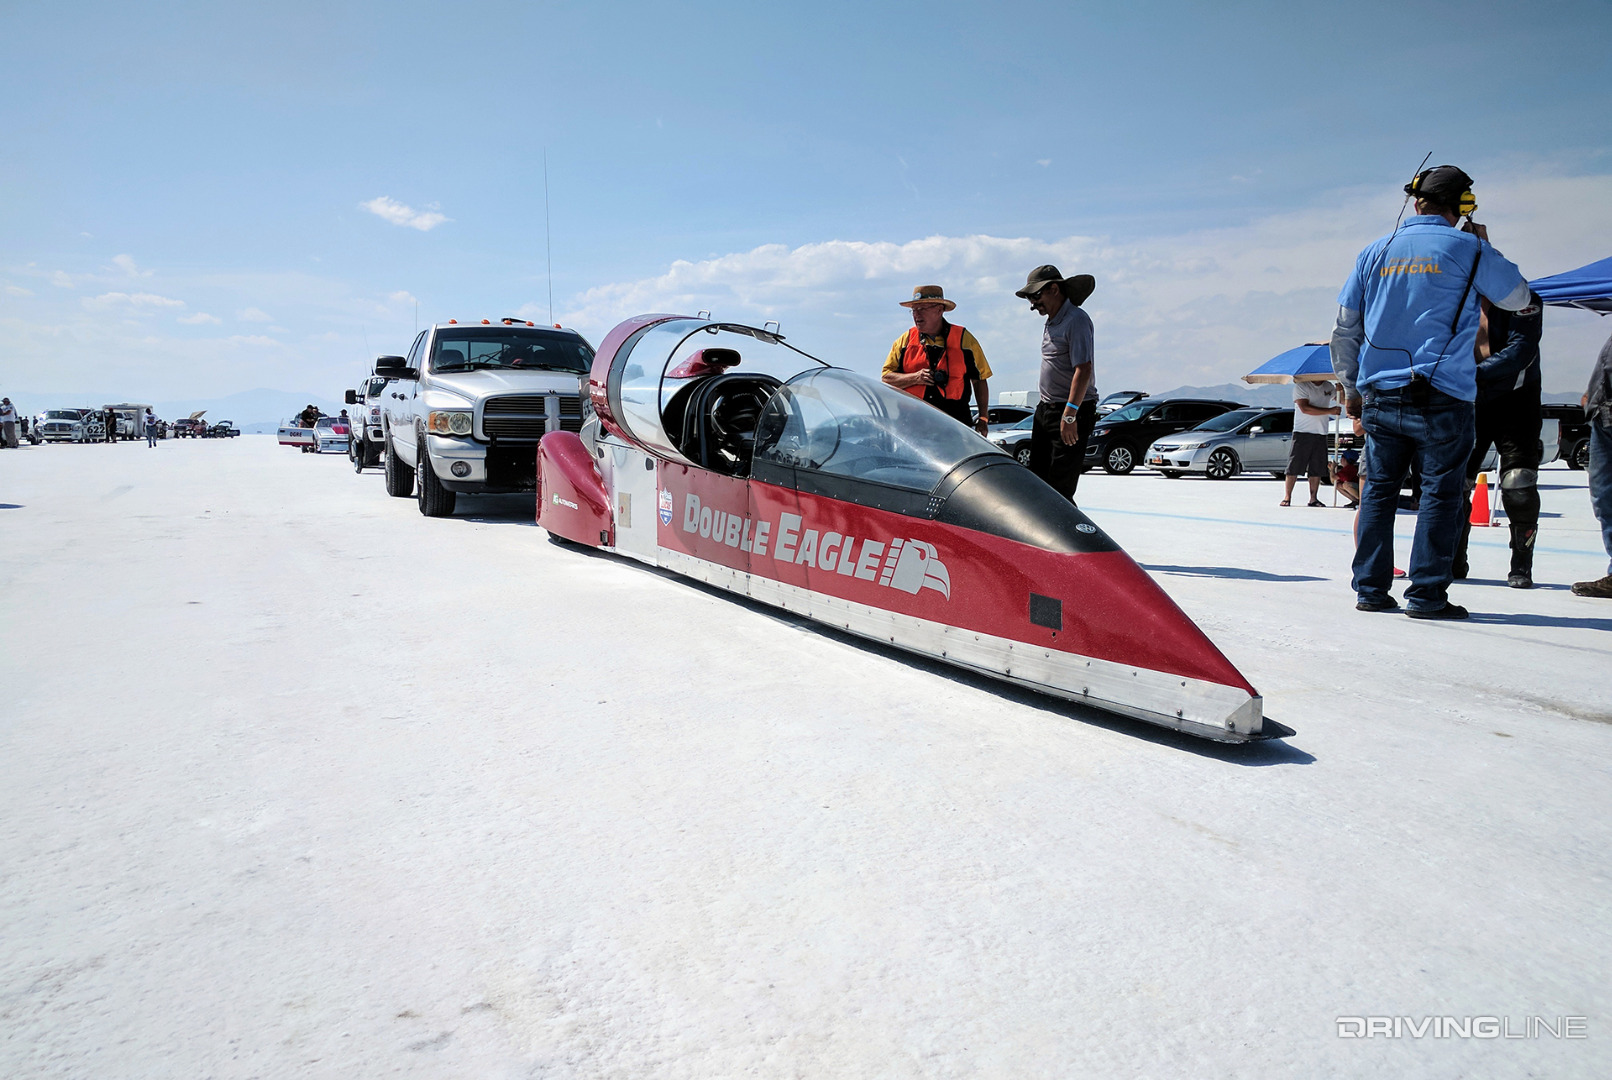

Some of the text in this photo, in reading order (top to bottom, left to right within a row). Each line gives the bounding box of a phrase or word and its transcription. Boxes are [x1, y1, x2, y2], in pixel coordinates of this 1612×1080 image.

[1380, 264, 1442, 277] OFFICIAL
[87, 425, 106, 434] 622
[683, 493, 885, 582] DOUBLE EAGLE
